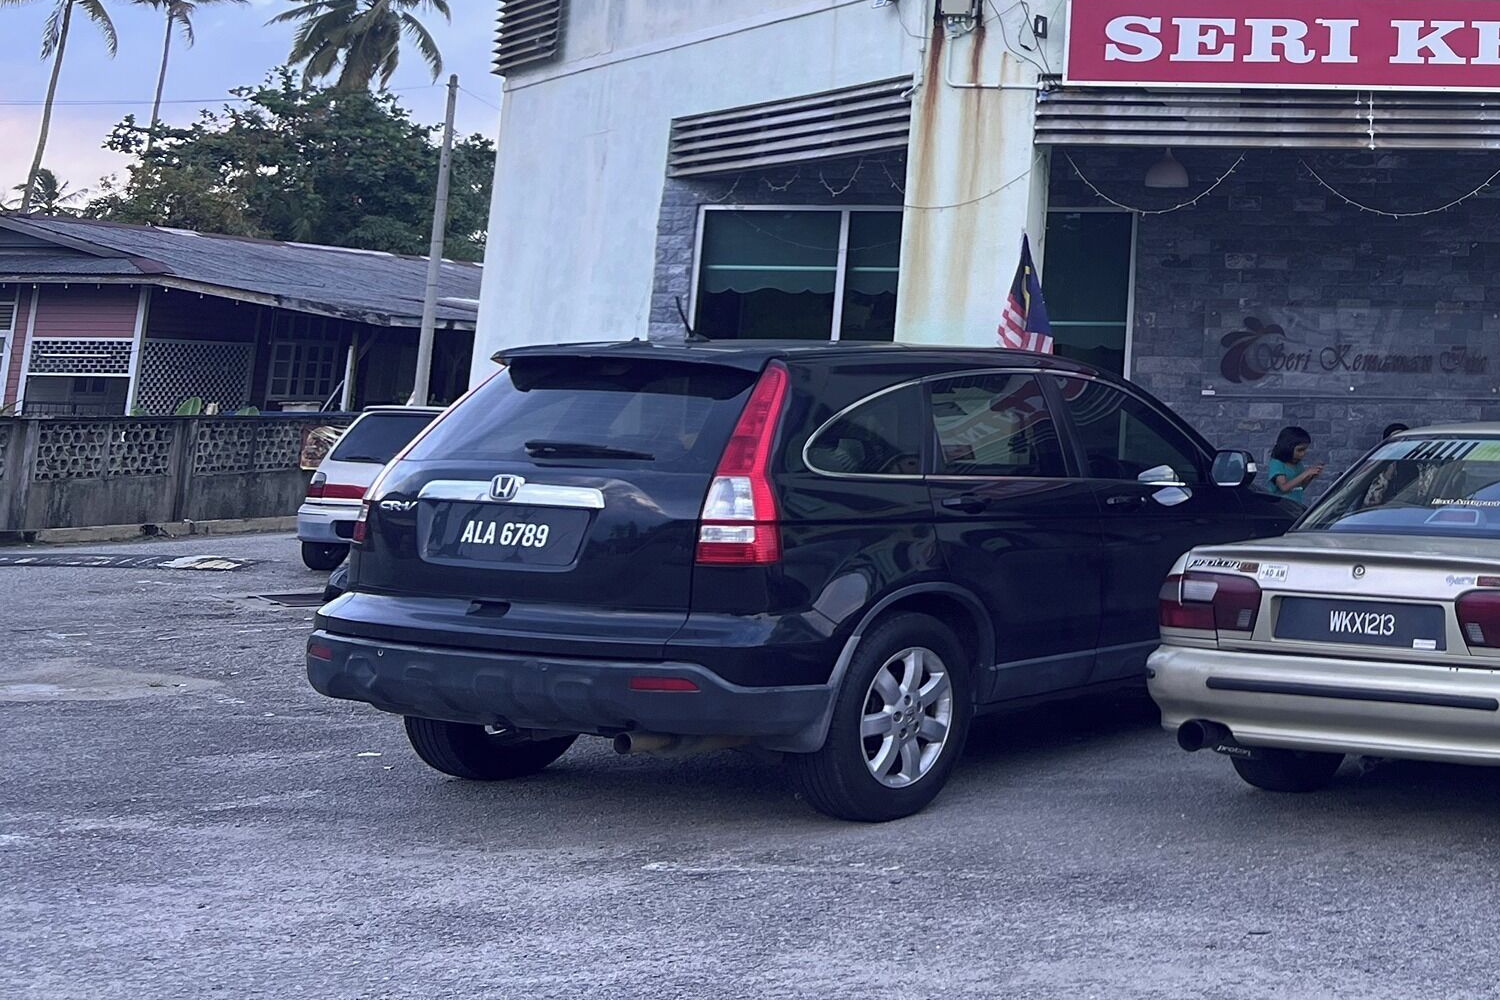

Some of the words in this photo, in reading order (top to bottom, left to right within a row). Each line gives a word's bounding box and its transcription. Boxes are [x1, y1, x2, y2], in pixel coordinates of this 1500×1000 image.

[1104, 15, 1360, 66] SERI
[1252, 342, 1311, 371] Seri
[1403, 441, 1480, 461] RALLI
[460, 520, 497, 545] ALA
[500, 522, 549, 548] 6789
[1188, 559, 1241, 569] proton
[1329, 610, 1396, 636] WKX1213
